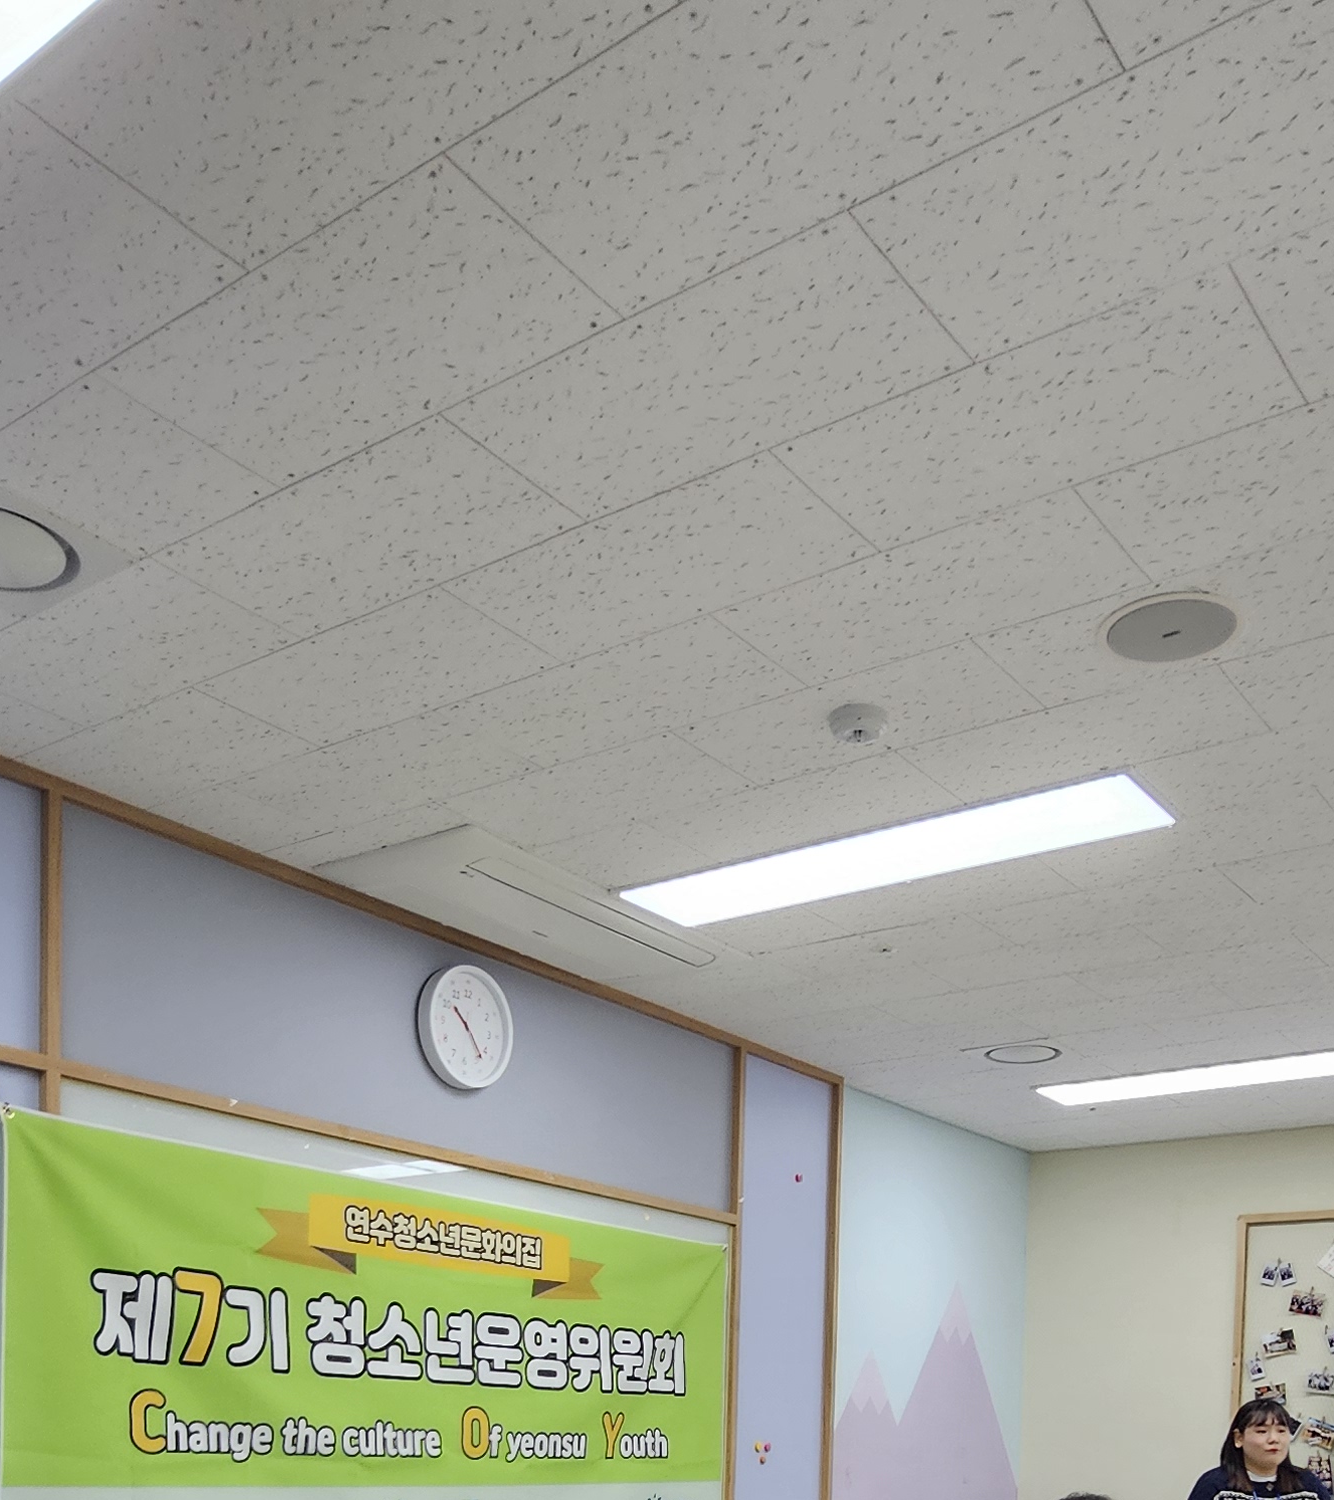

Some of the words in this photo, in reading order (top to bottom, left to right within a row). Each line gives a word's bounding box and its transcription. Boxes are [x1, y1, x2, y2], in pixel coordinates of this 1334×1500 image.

[345, 1205, 543, 1270] 연수청소년문화의집
[91, 1267, 290, 1374] 제7기
[305, 1292, 686, 1396] 청소년운영위원회
[129, 1388, 274, 1463] Change
[281, 1416, 336, 1456] the
[342, 1420, 442, 1458] culture
[462, 1406, 503, 1460] Of
[506, 1430, 587, 1463] yeonsu
[603, 1411, 668, 1459] Youth
